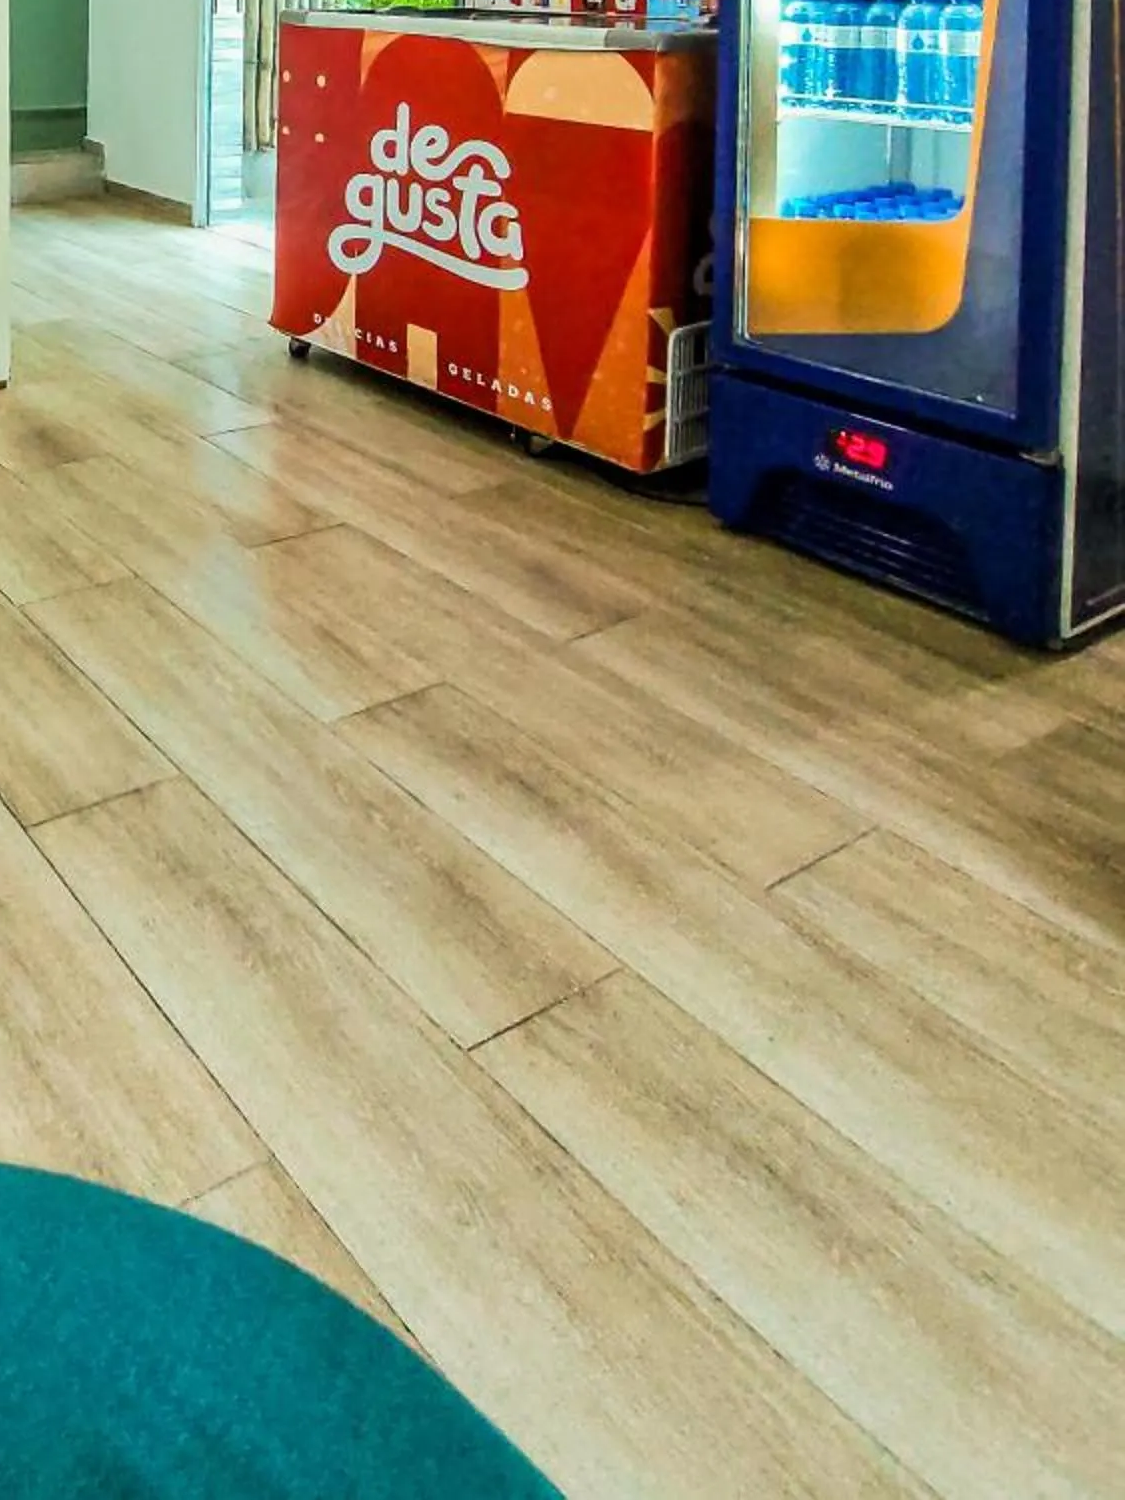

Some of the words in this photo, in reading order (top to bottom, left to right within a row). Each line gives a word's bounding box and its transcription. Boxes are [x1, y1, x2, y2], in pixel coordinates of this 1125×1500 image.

[370, 101, 511, 181] de
[328, 163, 530, 291] gusta
[447, 362, 553, 412] GELADAS
